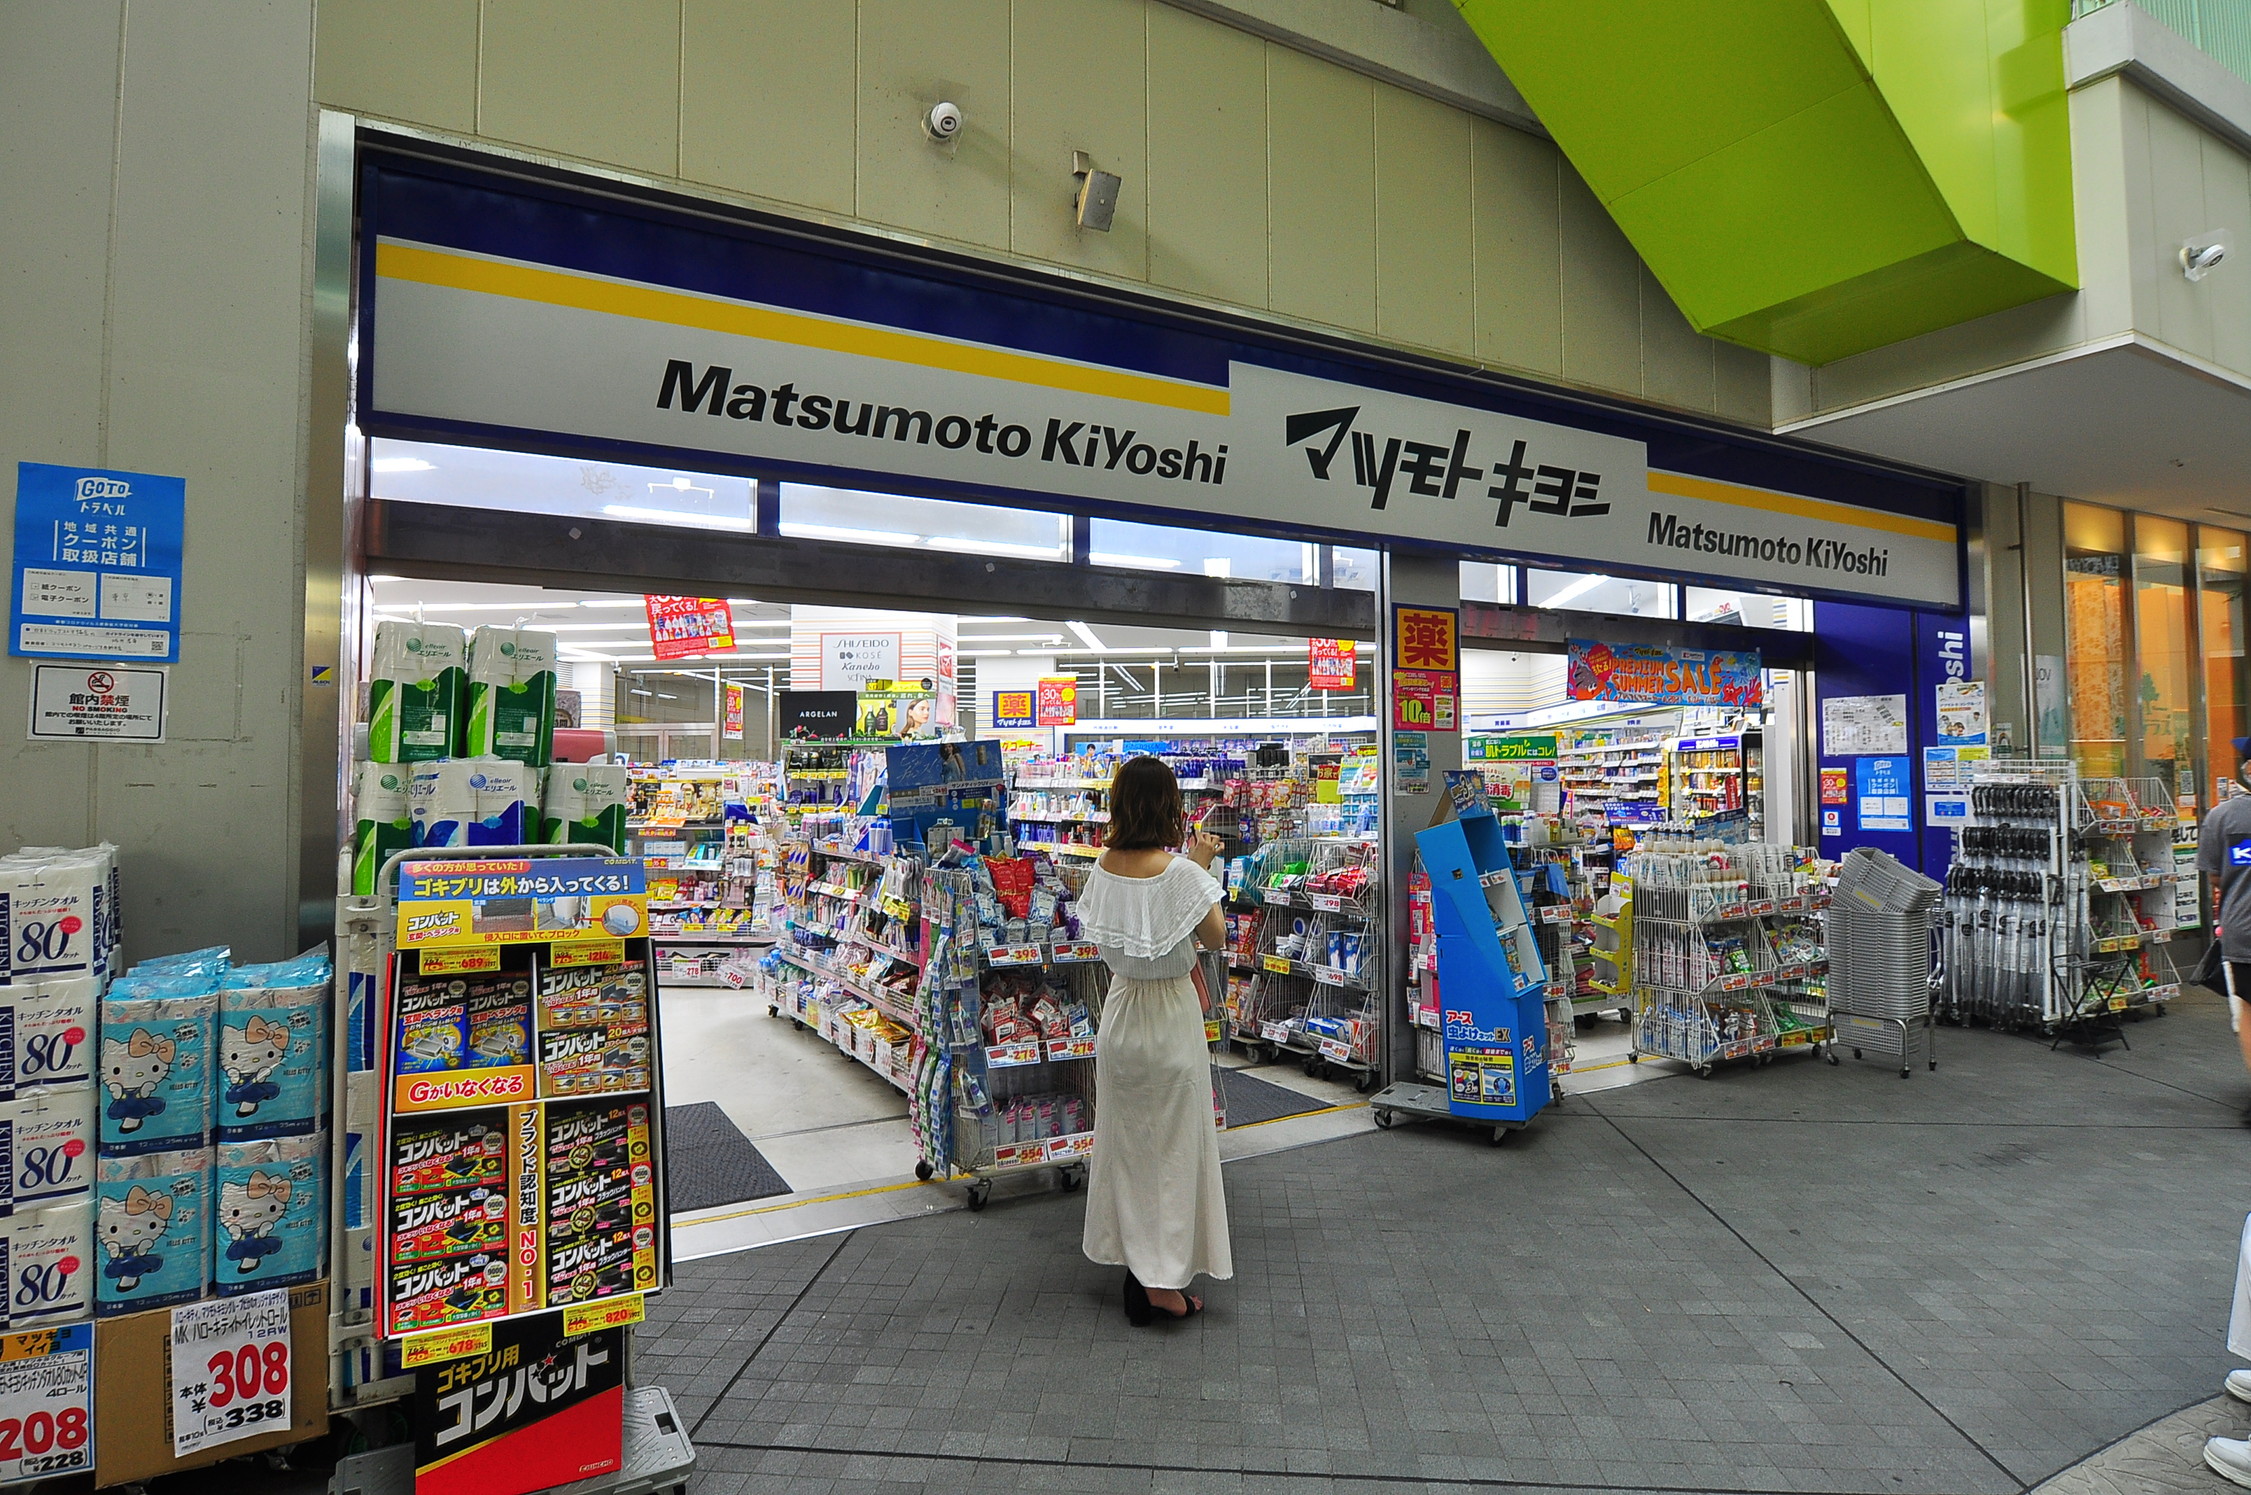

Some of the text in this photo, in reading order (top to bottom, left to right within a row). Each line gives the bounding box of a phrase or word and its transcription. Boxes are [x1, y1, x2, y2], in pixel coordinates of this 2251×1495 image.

[656, 359, 1229, 485] Matsumoto KiYoshi
[1286, 406, 1611, 527] マツモトキヨシ
[80, 502, 126, 516] トラベル
[64, 521, 137, 537] 地域共通
[64, 533, 136, 550] クーポン
[1647, 512, 1889, 577] Matsumoto KiYoshi
[62, 548, 136, 567] 取扱店舗
[651, 601, 698, 615] 戻ってくる!
[833, 639, 889, 648] SHISEIDO
[1404, 613, 1449, 667] 薬
[855, 651, 882, 660] KOSÉ
[842, 662, 880, 671] Kanebo
[1611, 656, 1665, 676] PREMIUM
[1611, 673, 1665, 693] SUMMER
[1665, 660, 1723, 695] SALE
[69, 692, 130, 706] 館内禁煙
[1003, 695, 1027, 716] 薬
[1486, 743, 1556, 758] 肌トラブルにはコレ!
[483, 784, 517, 792] エリエール
[412, 861, 525, 874] 多くの方が思っていた!
[414, 875, 629, 897] ゴキブリは外から入ってくる!
[12, 896, 80, 909] キッチンタオル
[407, 910, 460, 932] コンバット
[17, 920, 70, 963] 80
[484, 929, 580, 942] 侵入口に置いて、ブロック
[588, 951, 610, 961] 1214
[1014, 949, 1038, 960] 398
[1077, 946, 1099, 957] 398
[461, 958, 484, 968] 689
[542, 967, 603, 996] コンバット
[728, 971, 743, 984] 700
[402, 993, 449, 1012] コンバット
[469, 992, 514, 1012] コンバット
[17, 1006, 84, 1021] キッチンタオル
[1446, 1010, 1473, 1025] アース
[21, 1032, 73, 1076] 80
[544, 1031, 606, 1062] コンバット
[1013, 1049, 1036, 1060] 278
[1072, 1042, 1095, 1053] 278
[409, 1075, 524, 1102] Gがいなくなる
[15, 1118, 83, 1135] キッチンタオル
[550, 1114, 609, 1145] コンバット
[398, 1132, 469, 1165] コンバット
[1020, 1147, 1043, 1159] 554
[19, 1145, 73, 1189] 80
[519, 1110, 538, 1226] ブランド認知度
[551, 1174, 612, 1207] コンバット
[397, 1195, 470, 1232] コンバット
[12, 1235, 78, 1251] キッチンタオル
[552, 1238, 613, 1273] コンバット
[15, 1262, 66, 1306] 80
[395, 1262, 470, 1301] コンバット
[605, 1309, 629, 1323] 820
[174, 1325, 188, 1345] MK
[248, 1325, 288, 1339] 12RW
[25, 1341, 60, 1355] イイヨ
[449, 1340, 474, 1353] 678
[207, 1341, 288, 1408] 308
[437, 1344, 520, 1394] ゴキブリ用
[46, 1385, 87, 1398] 4ロール
[179, 1382, 207, 1399] 本体
[436, 1343, 609, 1447] コンバット
[0, 1407, 88, 1461] 208
